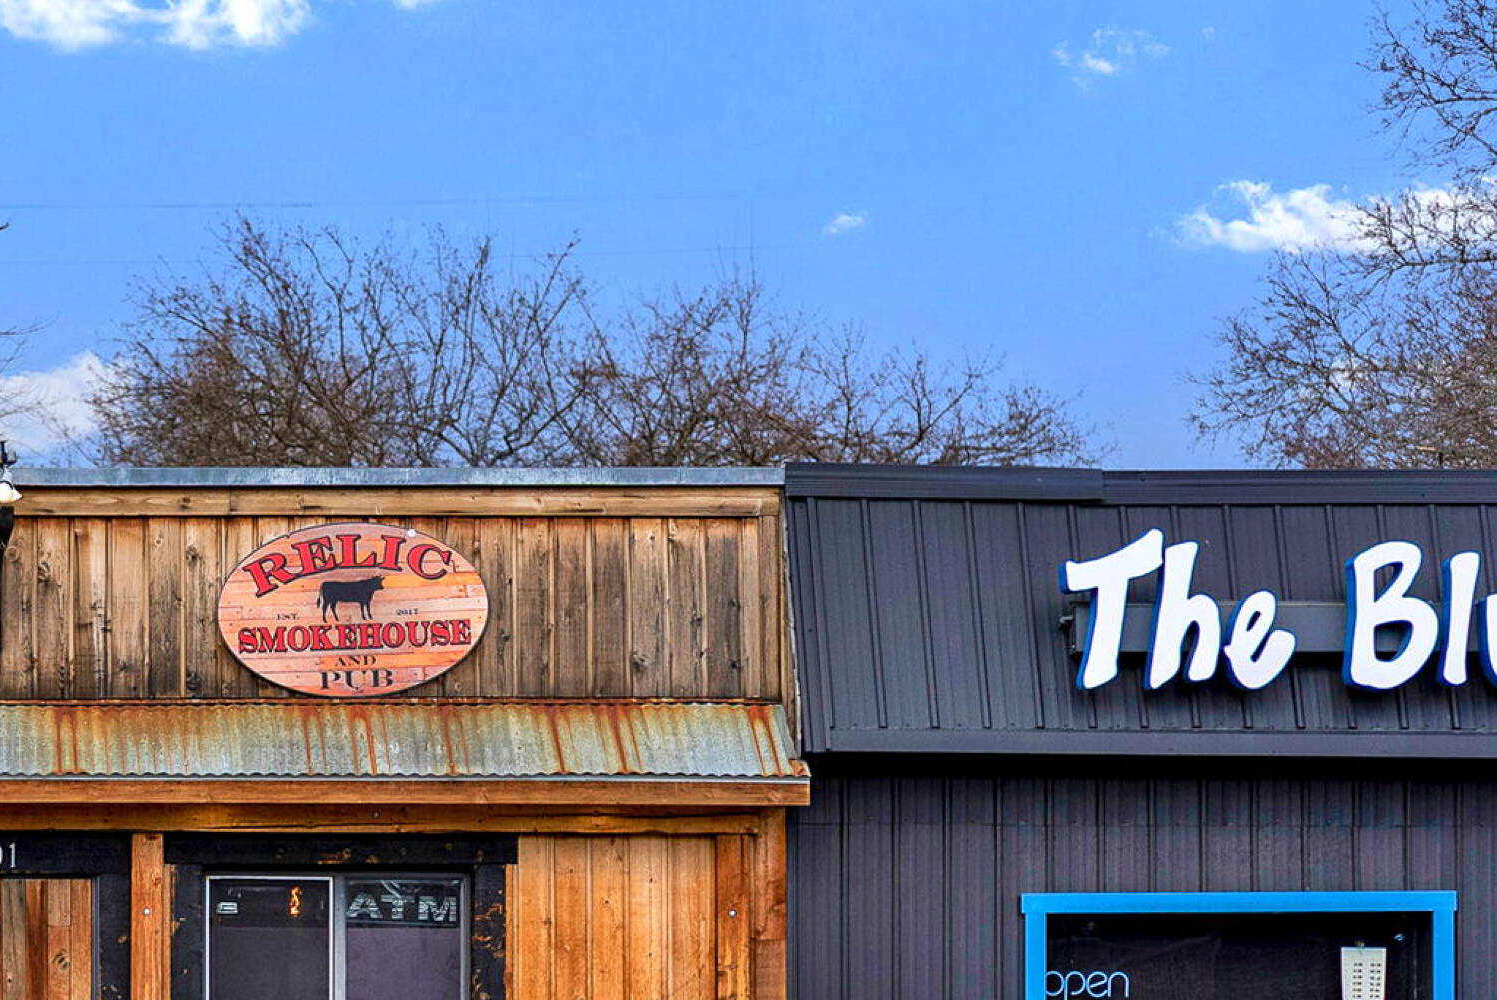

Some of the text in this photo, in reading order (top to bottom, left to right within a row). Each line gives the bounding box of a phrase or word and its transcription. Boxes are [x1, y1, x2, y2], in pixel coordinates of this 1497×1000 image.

[243, 534, 452, 597] RELIC
[1059, 528, 1296, 690] The
[238, 619, 472, 654] SMOKEHOUSE
[335, 655, 377, 667] AND
[319, 669, 394, 691] PUB
[346, 891, 457, 922] ATM
